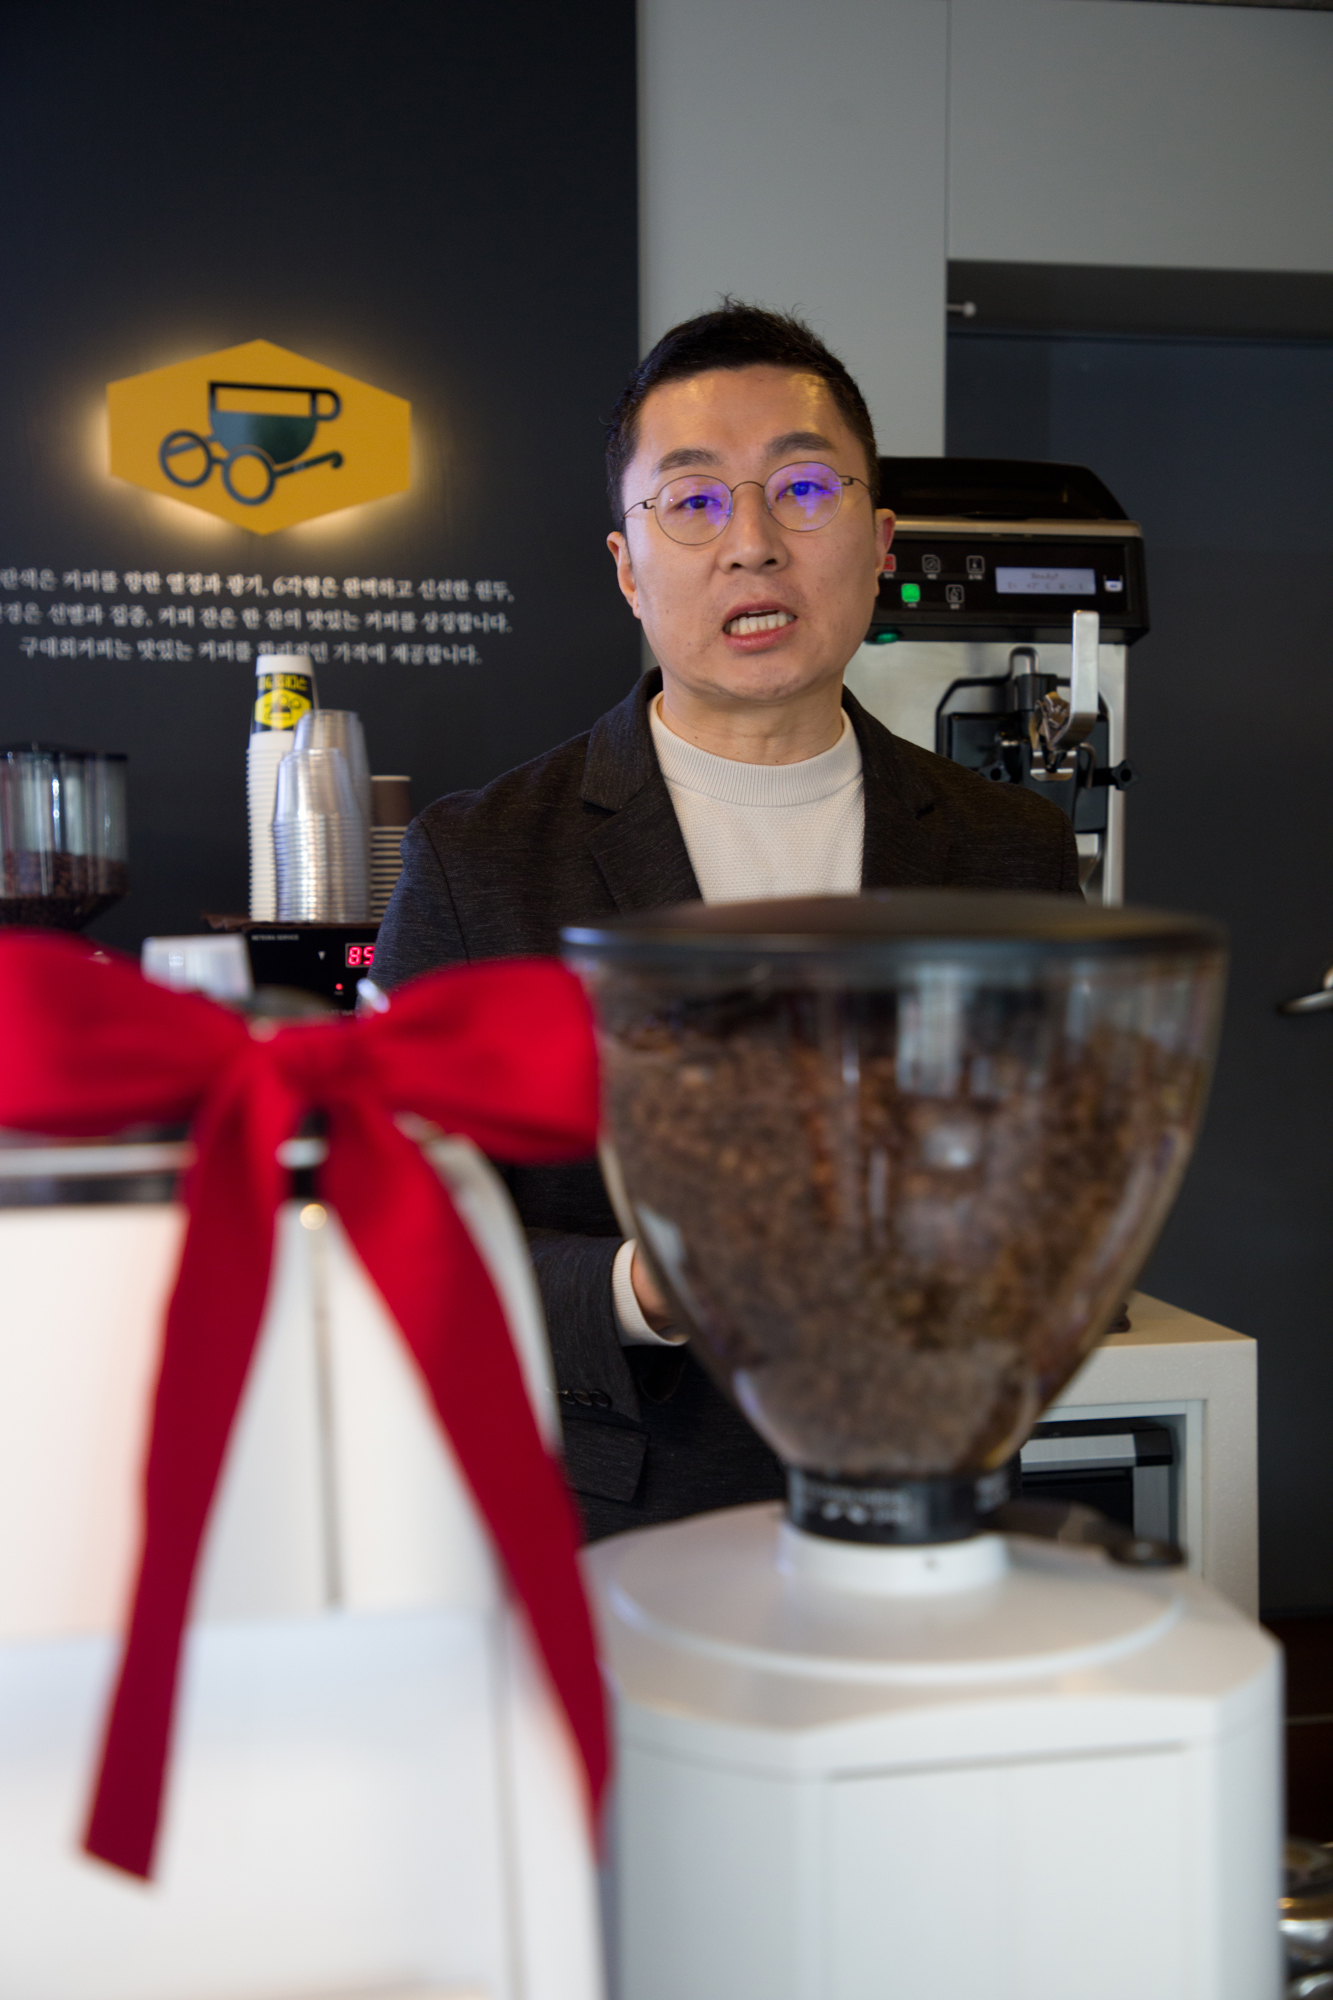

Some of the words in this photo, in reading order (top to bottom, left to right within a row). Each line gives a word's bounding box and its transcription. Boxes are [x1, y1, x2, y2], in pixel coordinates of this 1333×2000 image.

[62, 570, 119, 592] 커피를
[122, 571, 164, 593] 향한
[165, 573, 224, 594] 열정과
[272, 576, 340, 597] 6각형은
[342, 577, 413, 598] 완벽하고
[416, 579, 470, 600] 신선한
[157, 606, 194, 626] 커피
[199, 607, 239, 628] 잔은
[241, 608, 262, 629] 한
[264, 608, 301, 629] 잔의
[304, 609, 361, 630] 맛있는
[363, 611, 418, 631] 커피를
[420, 612, 512, 633] 상징합니다.
[136, 639, 194, 661] 맛있는
[198, 640, 253, 661] 커피를
[332, 643, 386, 663] 가격에
[390, 644, 482, 664] 제공합니다.
[348, 945, 375, 966] 85
